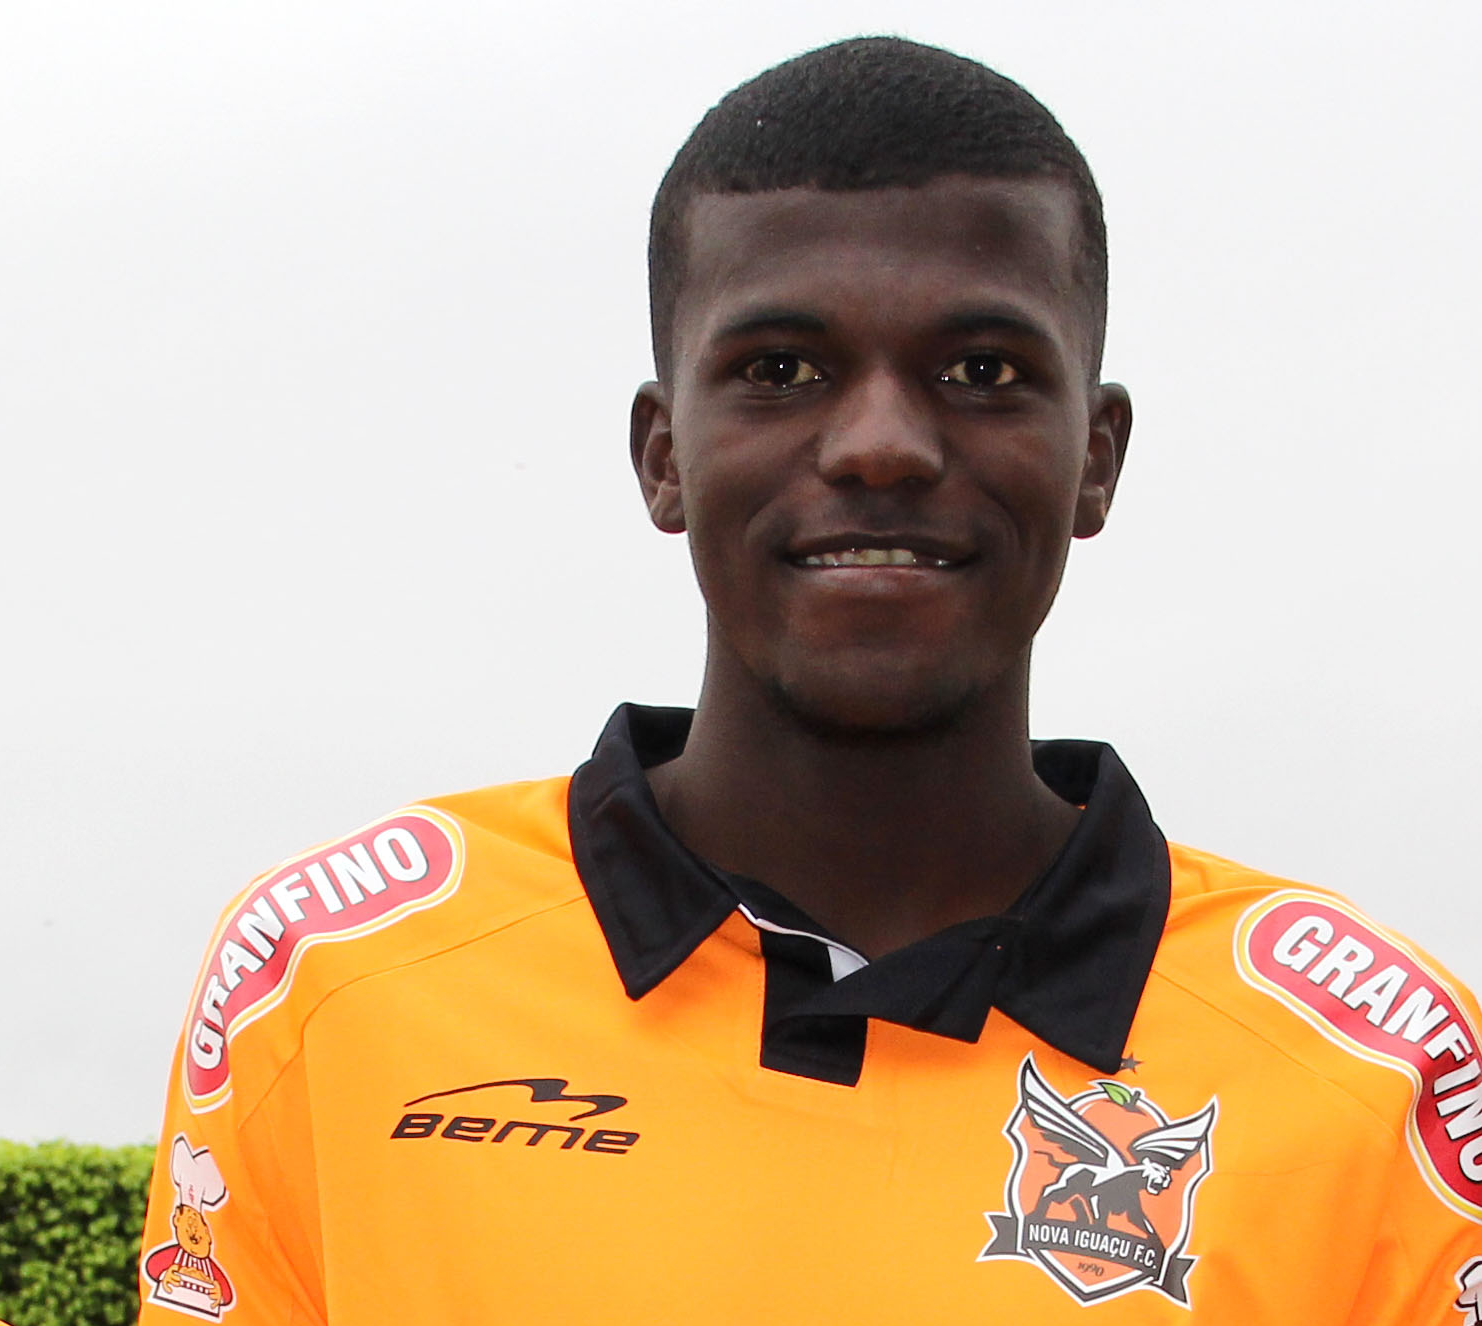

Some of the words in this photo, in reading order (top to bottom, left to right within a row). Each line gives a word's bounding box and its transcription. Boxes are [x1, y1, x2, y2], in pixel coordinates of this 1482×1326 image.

[189, 826, 430, 1070] GRANFINO
[1028, 1224, 1069, 1245] NOVA
[1074, 1229, 1130, 1258] IGUAÇU
